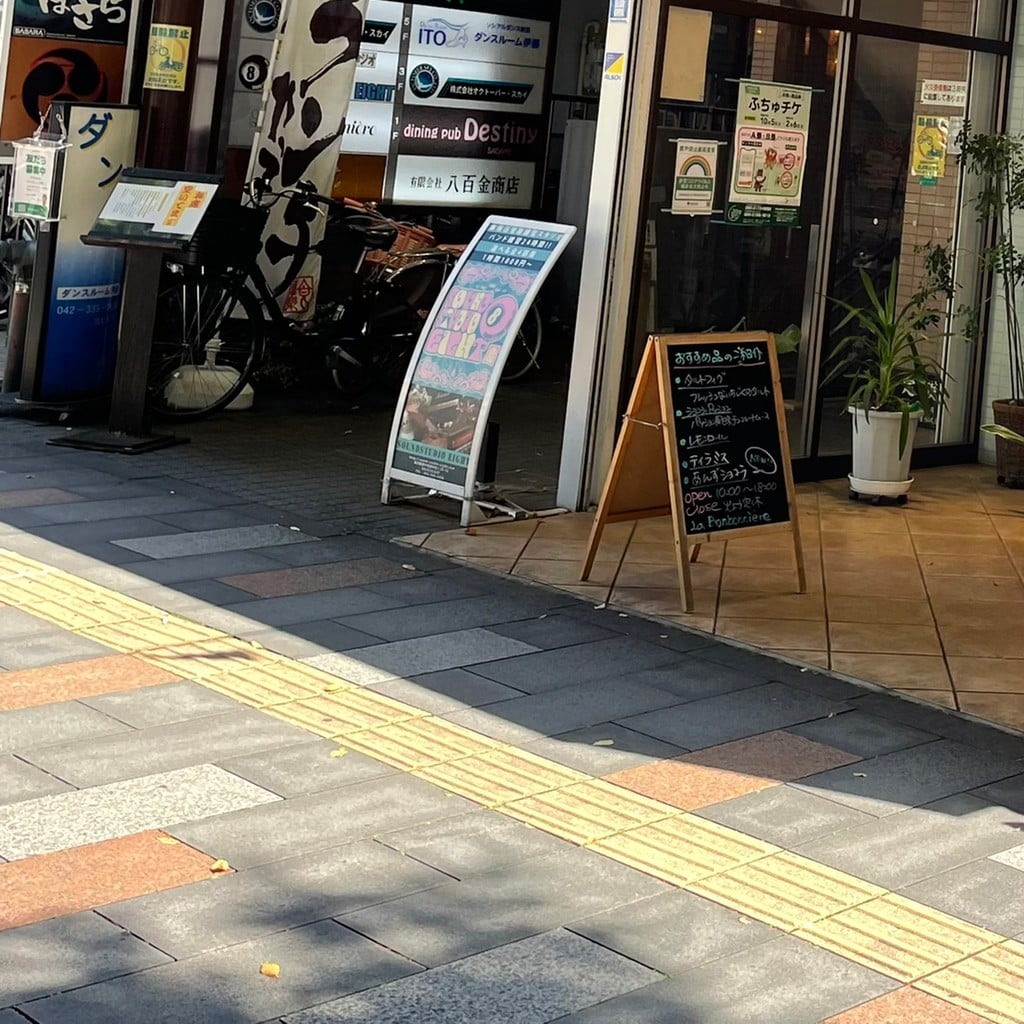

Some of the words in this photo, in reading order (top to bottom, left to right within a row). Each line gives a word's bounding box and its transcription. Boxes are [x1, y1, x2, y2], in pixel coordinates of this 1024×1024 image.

[418, 28, 447, 47] ITO
[749, 97, 802, 115] ふちゅチケ
[403, 124, 438, 139] dining
[441, 128, 461, 141] pub
[464, 117, 538, 145] Destiny
[446, 174, 520, 194] 八百金商店
[690, 451, 730, 466] ティラミス
